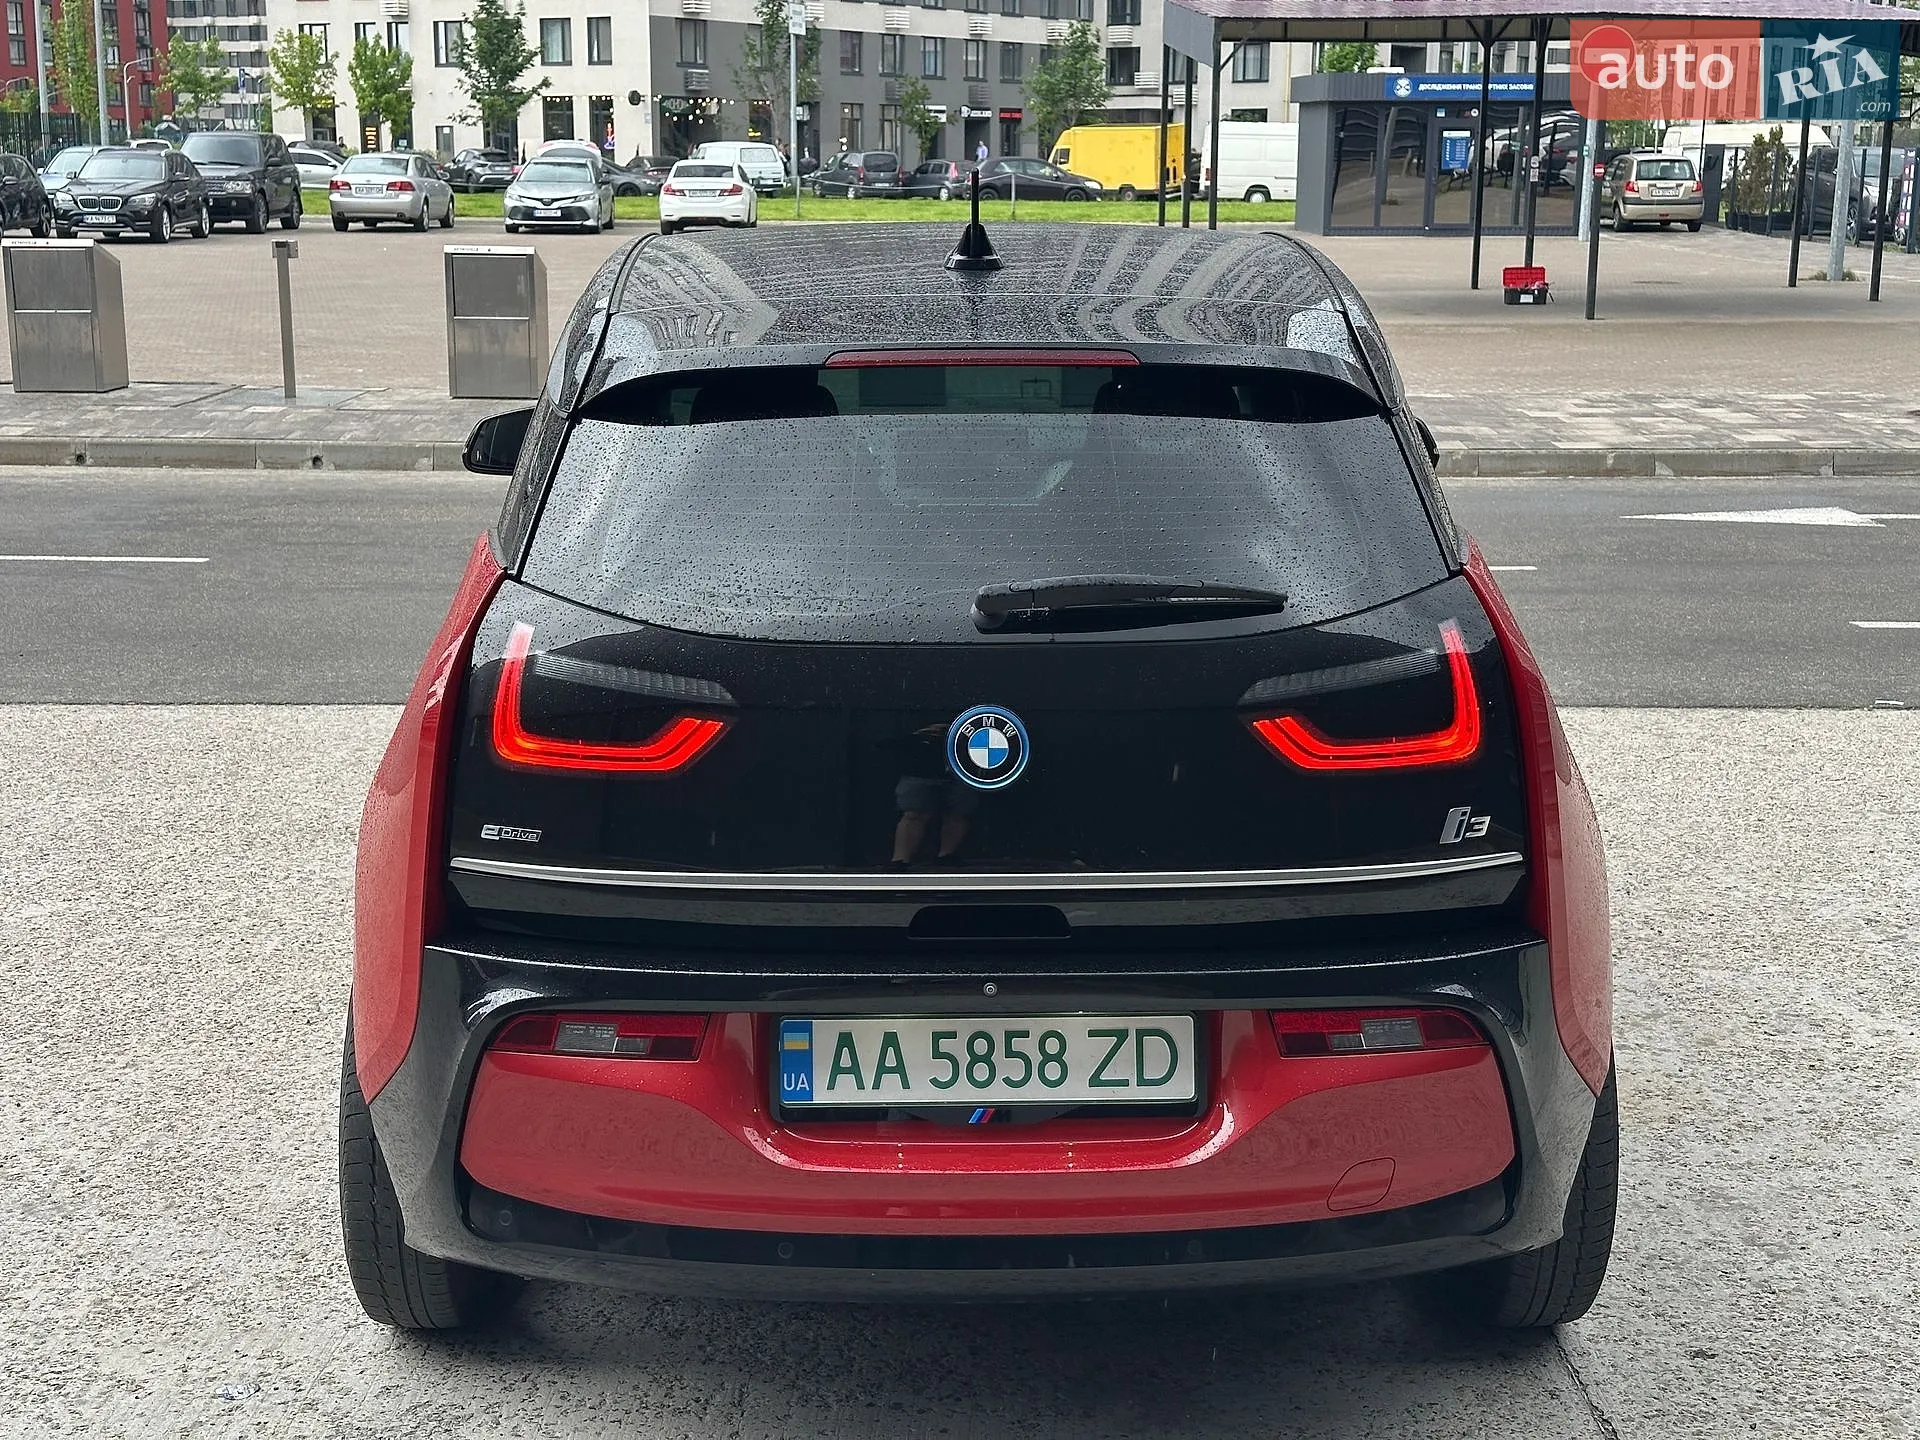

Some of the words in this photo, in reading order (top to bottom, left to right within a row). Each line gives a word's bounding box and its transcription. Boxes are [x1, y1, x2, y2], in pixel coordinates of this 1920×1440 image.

[1463, 83, 1508, 91] ТРАНСРТНИХ
[961, 716, 1017, 738] BMW
[1440, 807, 1491, 844] i3
[826, 1030, 911, 1090] AA
[928, 1029, 1069, 1089] 5858
[1087, 1028, 1180, 1088] ZD
[783, 1072, 810, 1092] UA
